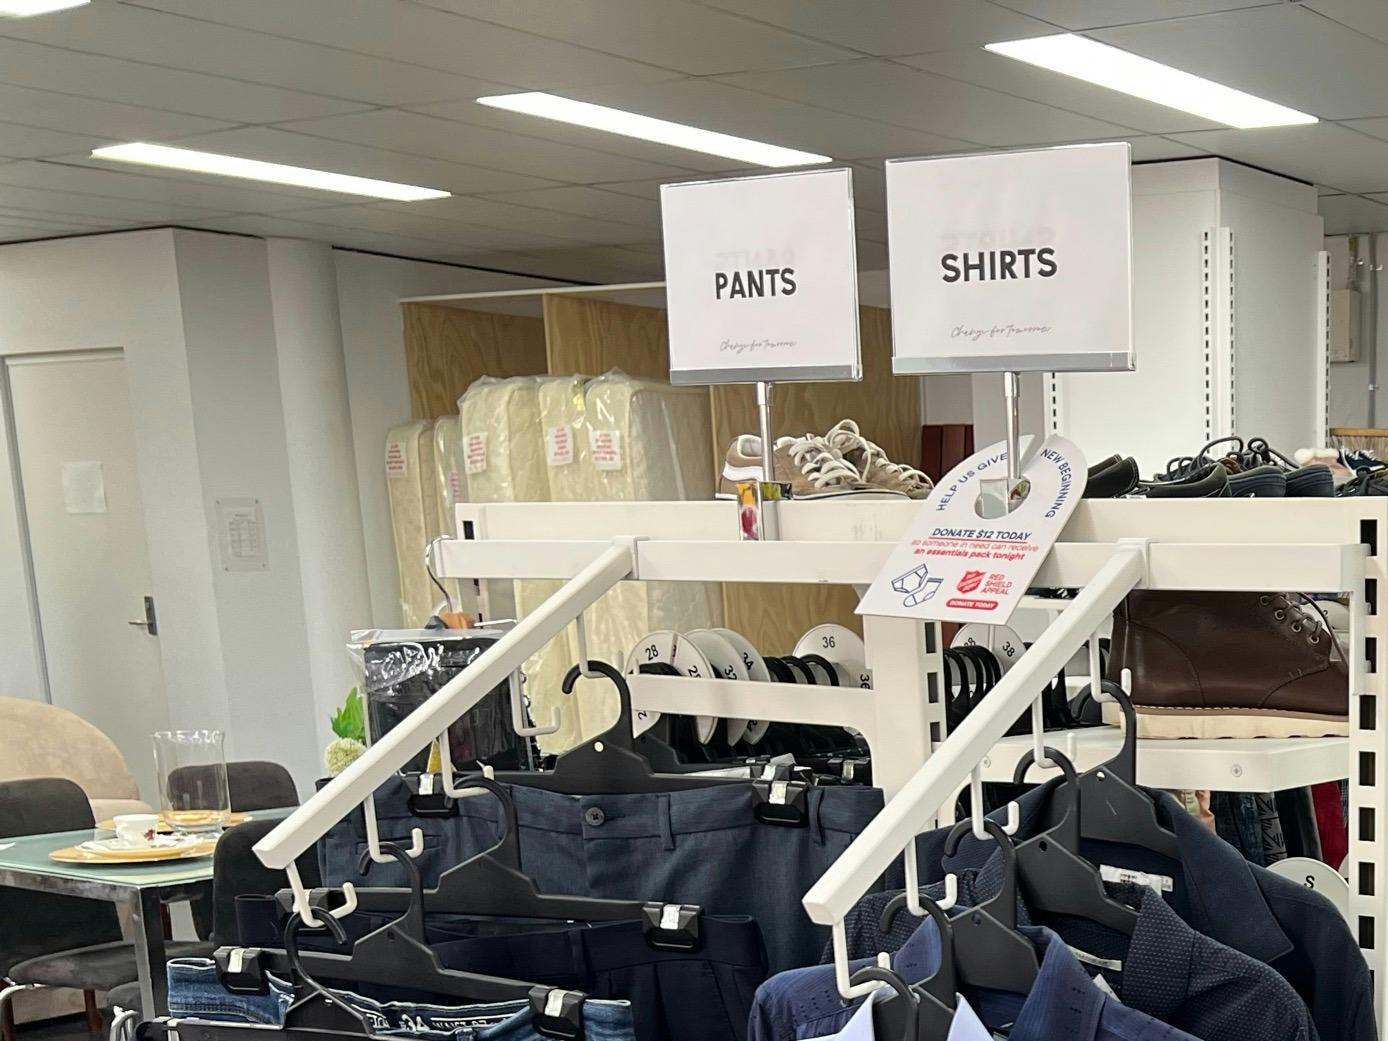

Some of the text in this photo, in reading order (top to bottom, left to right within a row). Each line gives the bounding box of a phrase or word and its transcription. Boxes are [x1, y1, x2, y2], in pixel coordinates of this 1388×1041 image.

[940, 247, 1058, 283] SHIRTS
[715, 267, 797, 300] PANTS
[936, 449, 1072, 518] HELP US GIVE NEW BEGINNING
[932, 528, 1032, 541] DONATE $12 TODAY
[921, 540, 959, 548] someone
[969, 541, 990, 549] need
[1008, 544, 1039, 552] receive
[926, 549, 969, 557] essentials
[969, 551, 990, 559] pack
[993, 552, 1026, 561] tonight
[822, 636, 836, 648] 36
[1002, 641, 1016, 658] 38
[644, 644, 659, 661] 28
[1303, 875, 1316, 889] S
